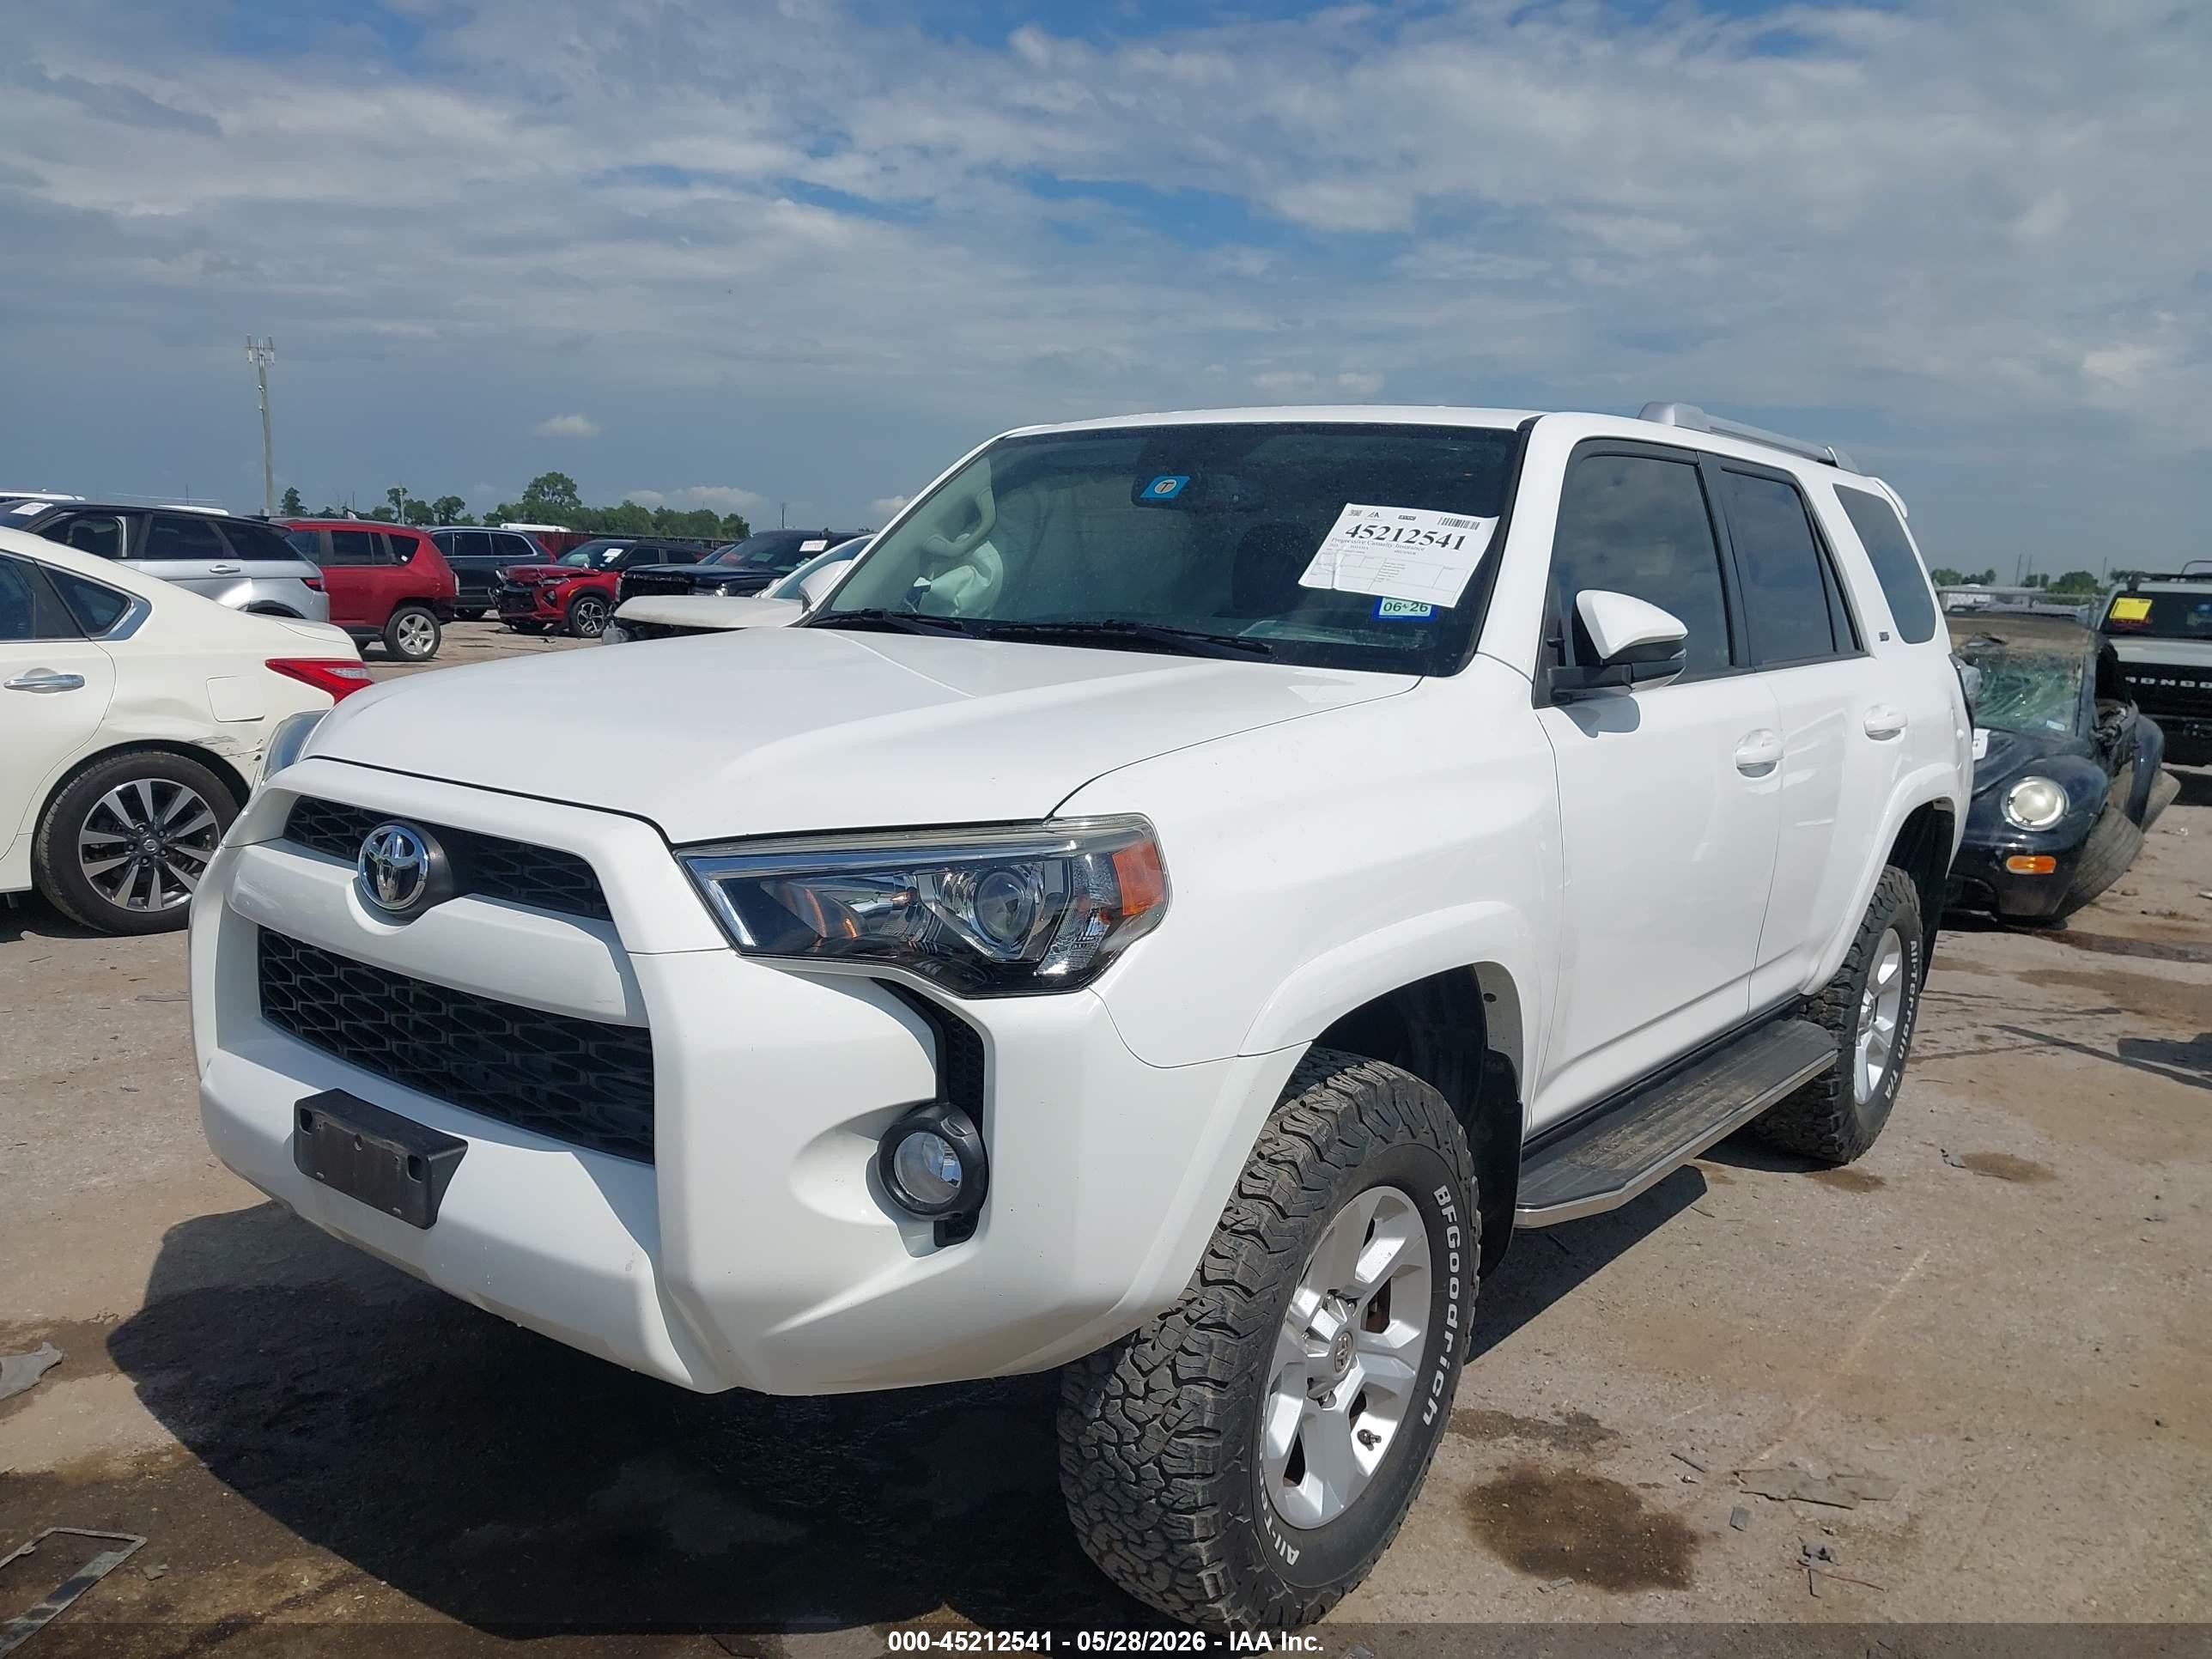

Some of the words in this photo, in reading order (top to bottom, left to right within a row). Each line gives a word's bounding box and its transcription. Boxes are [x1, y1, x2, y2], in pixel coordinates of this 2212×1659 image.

[1345, 524, 1467, 551] 45212541
[1897, 940, 1918, 1060] All-Terrain
[1884, 1069, 1899, 1100] T/A
[1422, 1184, 1462, 1425] BFGoodrich
